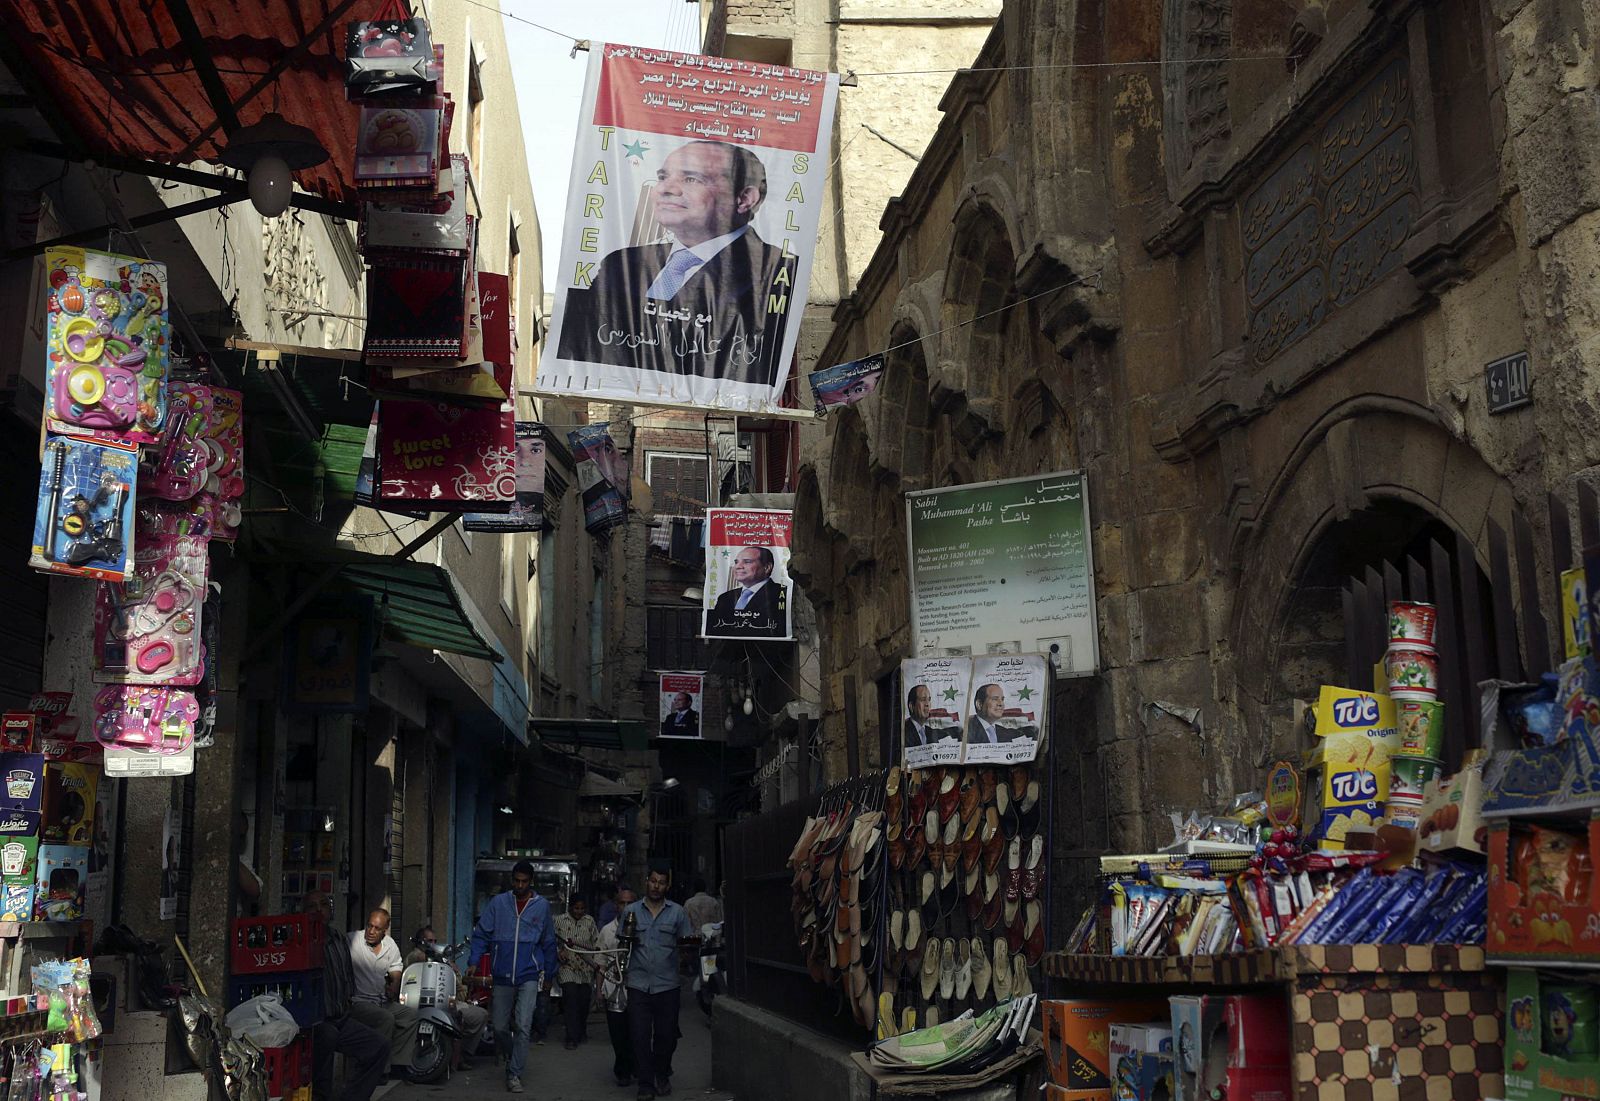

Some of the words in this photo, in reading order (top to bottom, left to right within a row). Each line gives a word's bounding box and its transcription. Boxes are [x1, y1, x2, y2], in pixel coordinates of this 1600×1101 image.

[642, 52, 672, 64] الدرب
[708, 56, 734, 74] يونية
[738, 61, 748, 71] ٣٠
[750, 65, 757, 76] و
[760, 65, 784, 80] يناير
[639, 73, 664, 84] مصر
[666, 72, 700, 92] جنرال
[702, 79, 737, 94] الرابع
[738, 84, 768, 98] الهرم
[642, 92, 665, 108] للبلاد
[667, 94, 688, 112] رئيسا
[770, 87, 811, 106] يؤيدون
[722, 101, 748, 118] الفتاح
[750, 106, 767, 120] عبد
[776, 110, 801, 125] السيد
[684, 119, 730, 138] للشهداء
[732, 126, 761, 142] المجد
[574, 127, 615, 287] TAREK
[768, 154, 809, 314] SALLAM
[482, 290, 498, 306] for
[644, 302, 691, 322] تحيات
[694, 313, 712, 327] مع
[675, 328, 722, 357] عادل
[730, 315, 764, 366] الحاج
[1490, 370, 1503, 402] ٤٠
[1510, 360, 1529, 398] 40
[392, 434, 452, 456] Sweet
[1036, 480, 1080, 493] سبيل
[915, 496, 938, 508] Sabil
[1039, 492, 1080, 504] محمد
[920, 504, 975, 520] Muhammad
[1001, 511, 1030, 524] باشا
[967, 516, 993, 528] Pasha
[950, 552, 964, 560] 1820
[754, 610, 760, 618] مع
[924, 662, 938, 670] مصر
[938, 660, 952, 668] تحيا
[996, 660, 1010, 668] مصر
[1010, 658, 1024, 667] تحيا
[32, 696, 66, 717] Play
[1336, 700, 1378, 724] TUC
[1367, 727, 1400, 738] Origina
[41, 744, 66, 758] Play
[1333, 773, 1376, 798] TUC
